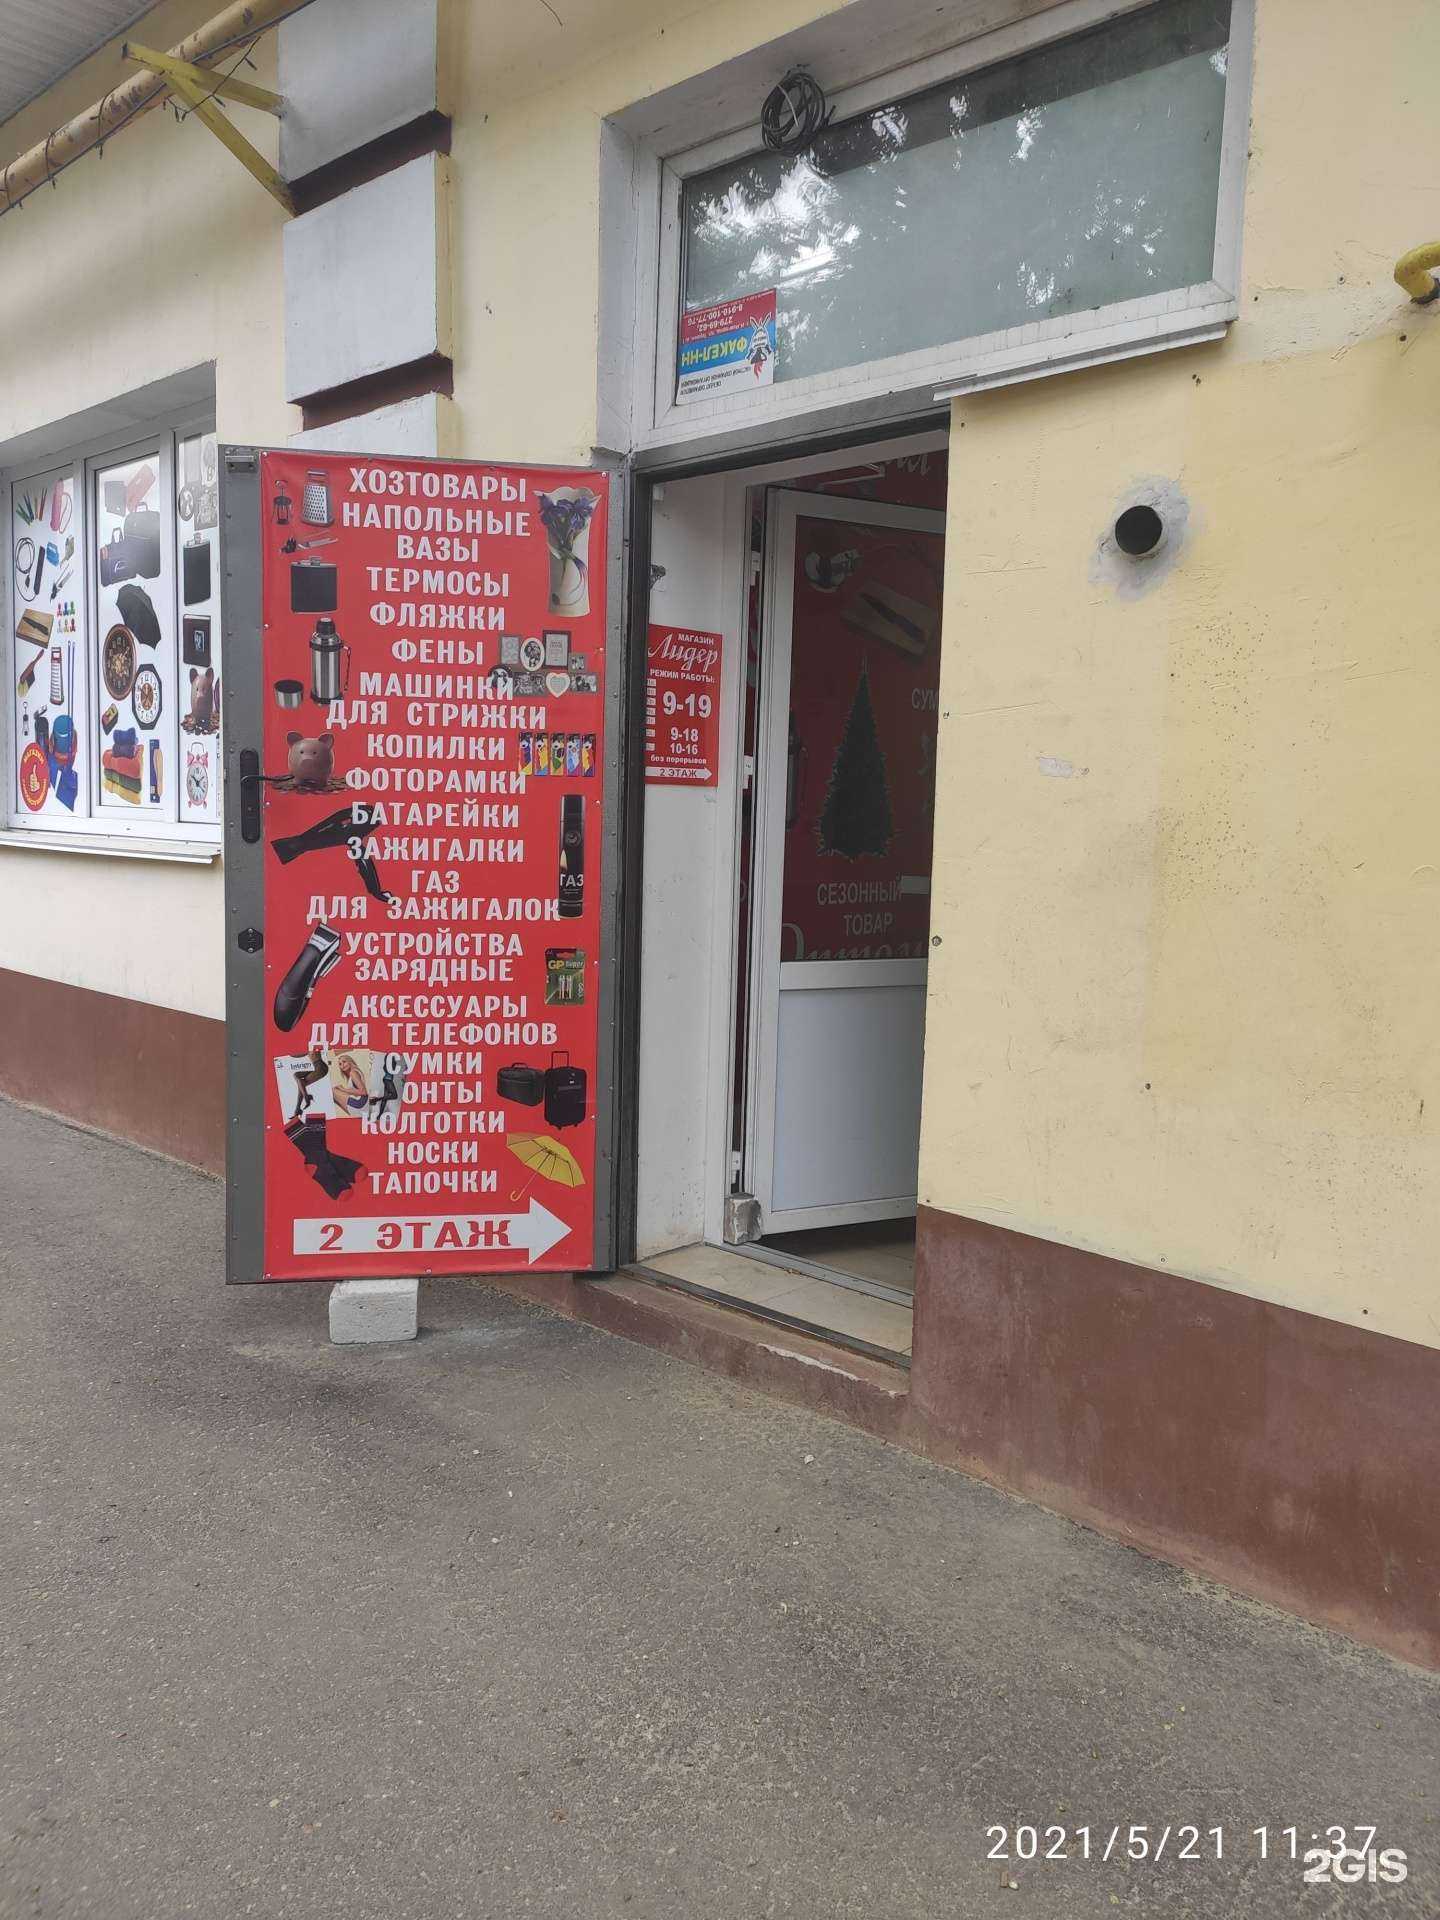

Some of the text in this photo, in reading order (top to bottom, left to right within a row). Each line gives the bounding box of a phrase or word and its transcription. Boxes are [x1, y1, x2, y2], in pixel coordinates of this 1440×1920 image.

[681, 336, 747, 366] ФАКЕЛ-НН
[348, 467, 527, 502] ХОЗТОВАРЫ
[342, 502, 531, 537] НАПОЛЬНЫЕ
[396, 535, 479, 563] ВАЗЫ
[365, 566, 509, 597] ТЕРМОСЫ
[369, 601, 505, 631] ФЛЯЖКИ
[391, 638, 484, 665] ФЕНЫ
[647, 633, 718, 673] Лидер
[677, 633, 715, 646] МАГАЗИН
[359, 671, 514, 701] МАШИНКИ
[650, 669, 679, 679] РЕЖИМ
[325, 700, 547, 730] ДЛЯ СТРИЖКИ
[662, 691, 712, 719] 9-19
[367, 733, 505, 761] КОПИЛКИ
[670, 726, 699, 742] 9-18
[669, 742, 698, 755] 10-16
[344, 766, 527, 795] ФОТОРАМКИ
[659, 768, 697, 777] 2 ЭТАЖ
[350, 799, 520, 828] БАТАРЕЙКИ
[346, 835, 524, 863] ЗАЖИГАЛКИ
[410, 870, 460, 893] ГАЗ
[559, 873, 584, 888] ГАЗ
[816, 871, 903, 906] СЕЗОННЫЙ
[306, 896, 560, 925] ДЛЯ ЗАЖИГАЛОК
[843, 911, 894, 937] ТОВАР
[345, 927, 524, 957] УСТРОЙСТВА
[354, 958, 515, 988] ЗАРЯДНЫЕ
[547, 959, 564, 970] GP
[341, 994, 528, 1019] АКСЕССУАРЫ
[308, 1022, 558, 1052] ДЛЯ ТЕЛЕФОНОВ
[385, 1050, 482, 1076] СУМКИ
[401, 1080, 482, 1106] ОНТЫ
[360, 1109, 506, 1136] КОЛГОТКИ
[387, 1140, 478, 1165] НОСКИ
[367, 1170, 498, 1195] ТАПОЧКИ
[318, 1219, 511, 1252] 2 ЭТАЖ
